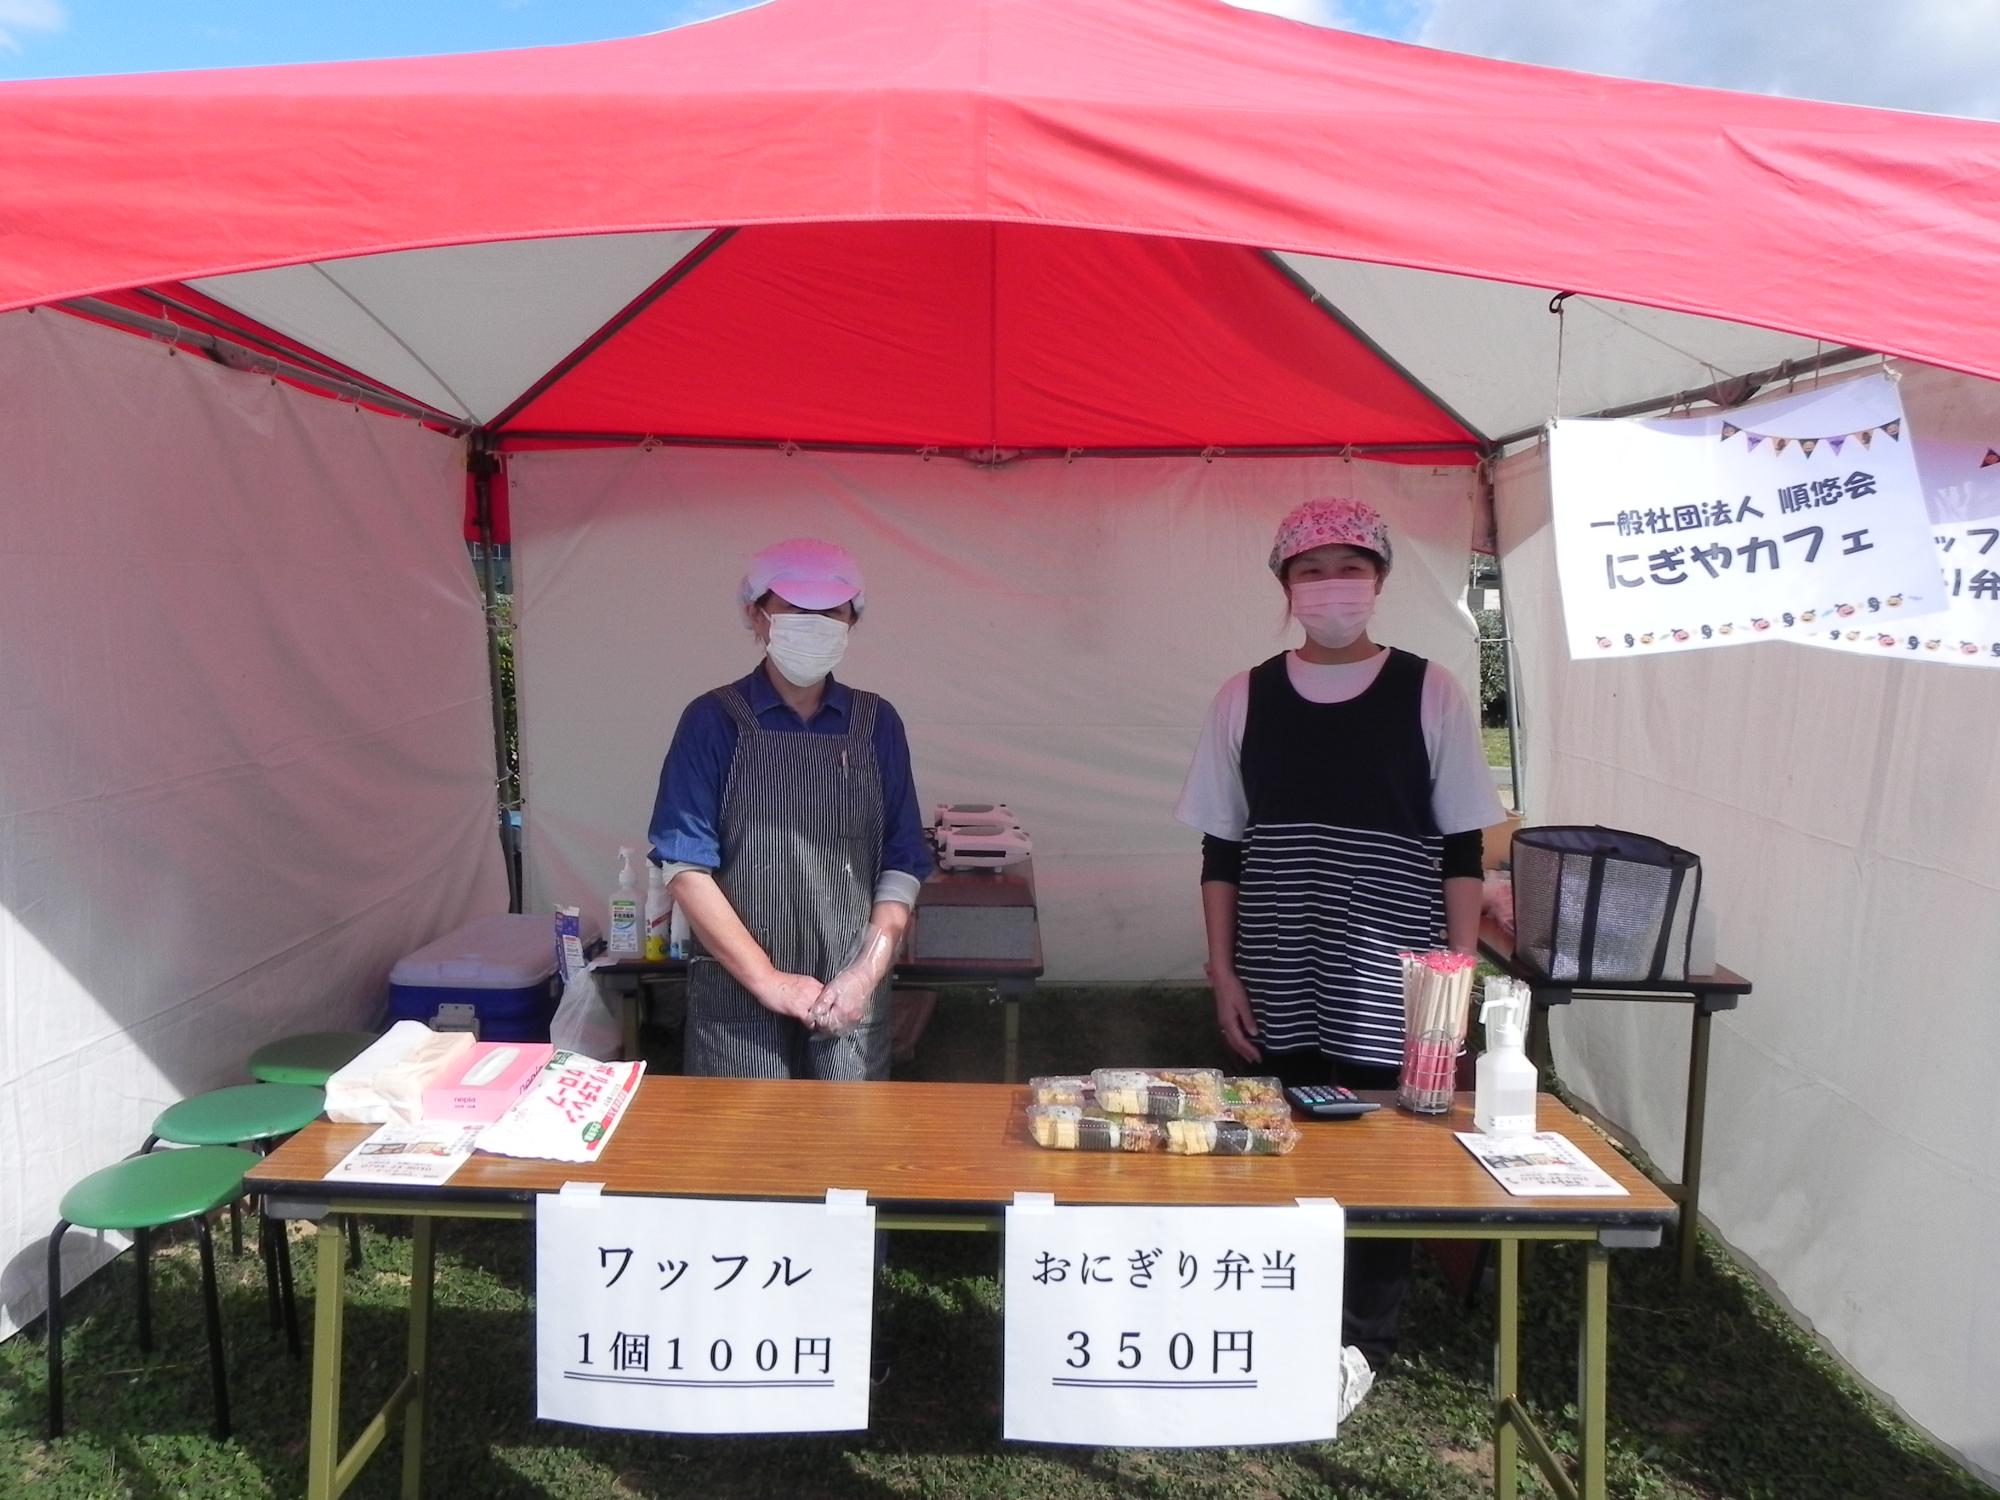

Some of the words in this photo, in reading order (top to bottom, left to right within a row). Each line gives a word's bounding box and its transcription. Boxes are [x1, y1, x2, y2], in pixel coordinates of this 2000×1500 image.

[1590, 495, 1764, 536] 一般社団法人
[1778, 471, 1877, 514] 順悠会
[1606, 526, 1874, 589] にぎやカフェ
[599, 1247, 812, 1290] ワッフル
[1033, 1248, 1297, 1291] おにぎり弁当
[575, 1331, 832, 1374] 1個100円
[1065, 1330, 1255, 1374] 350円
